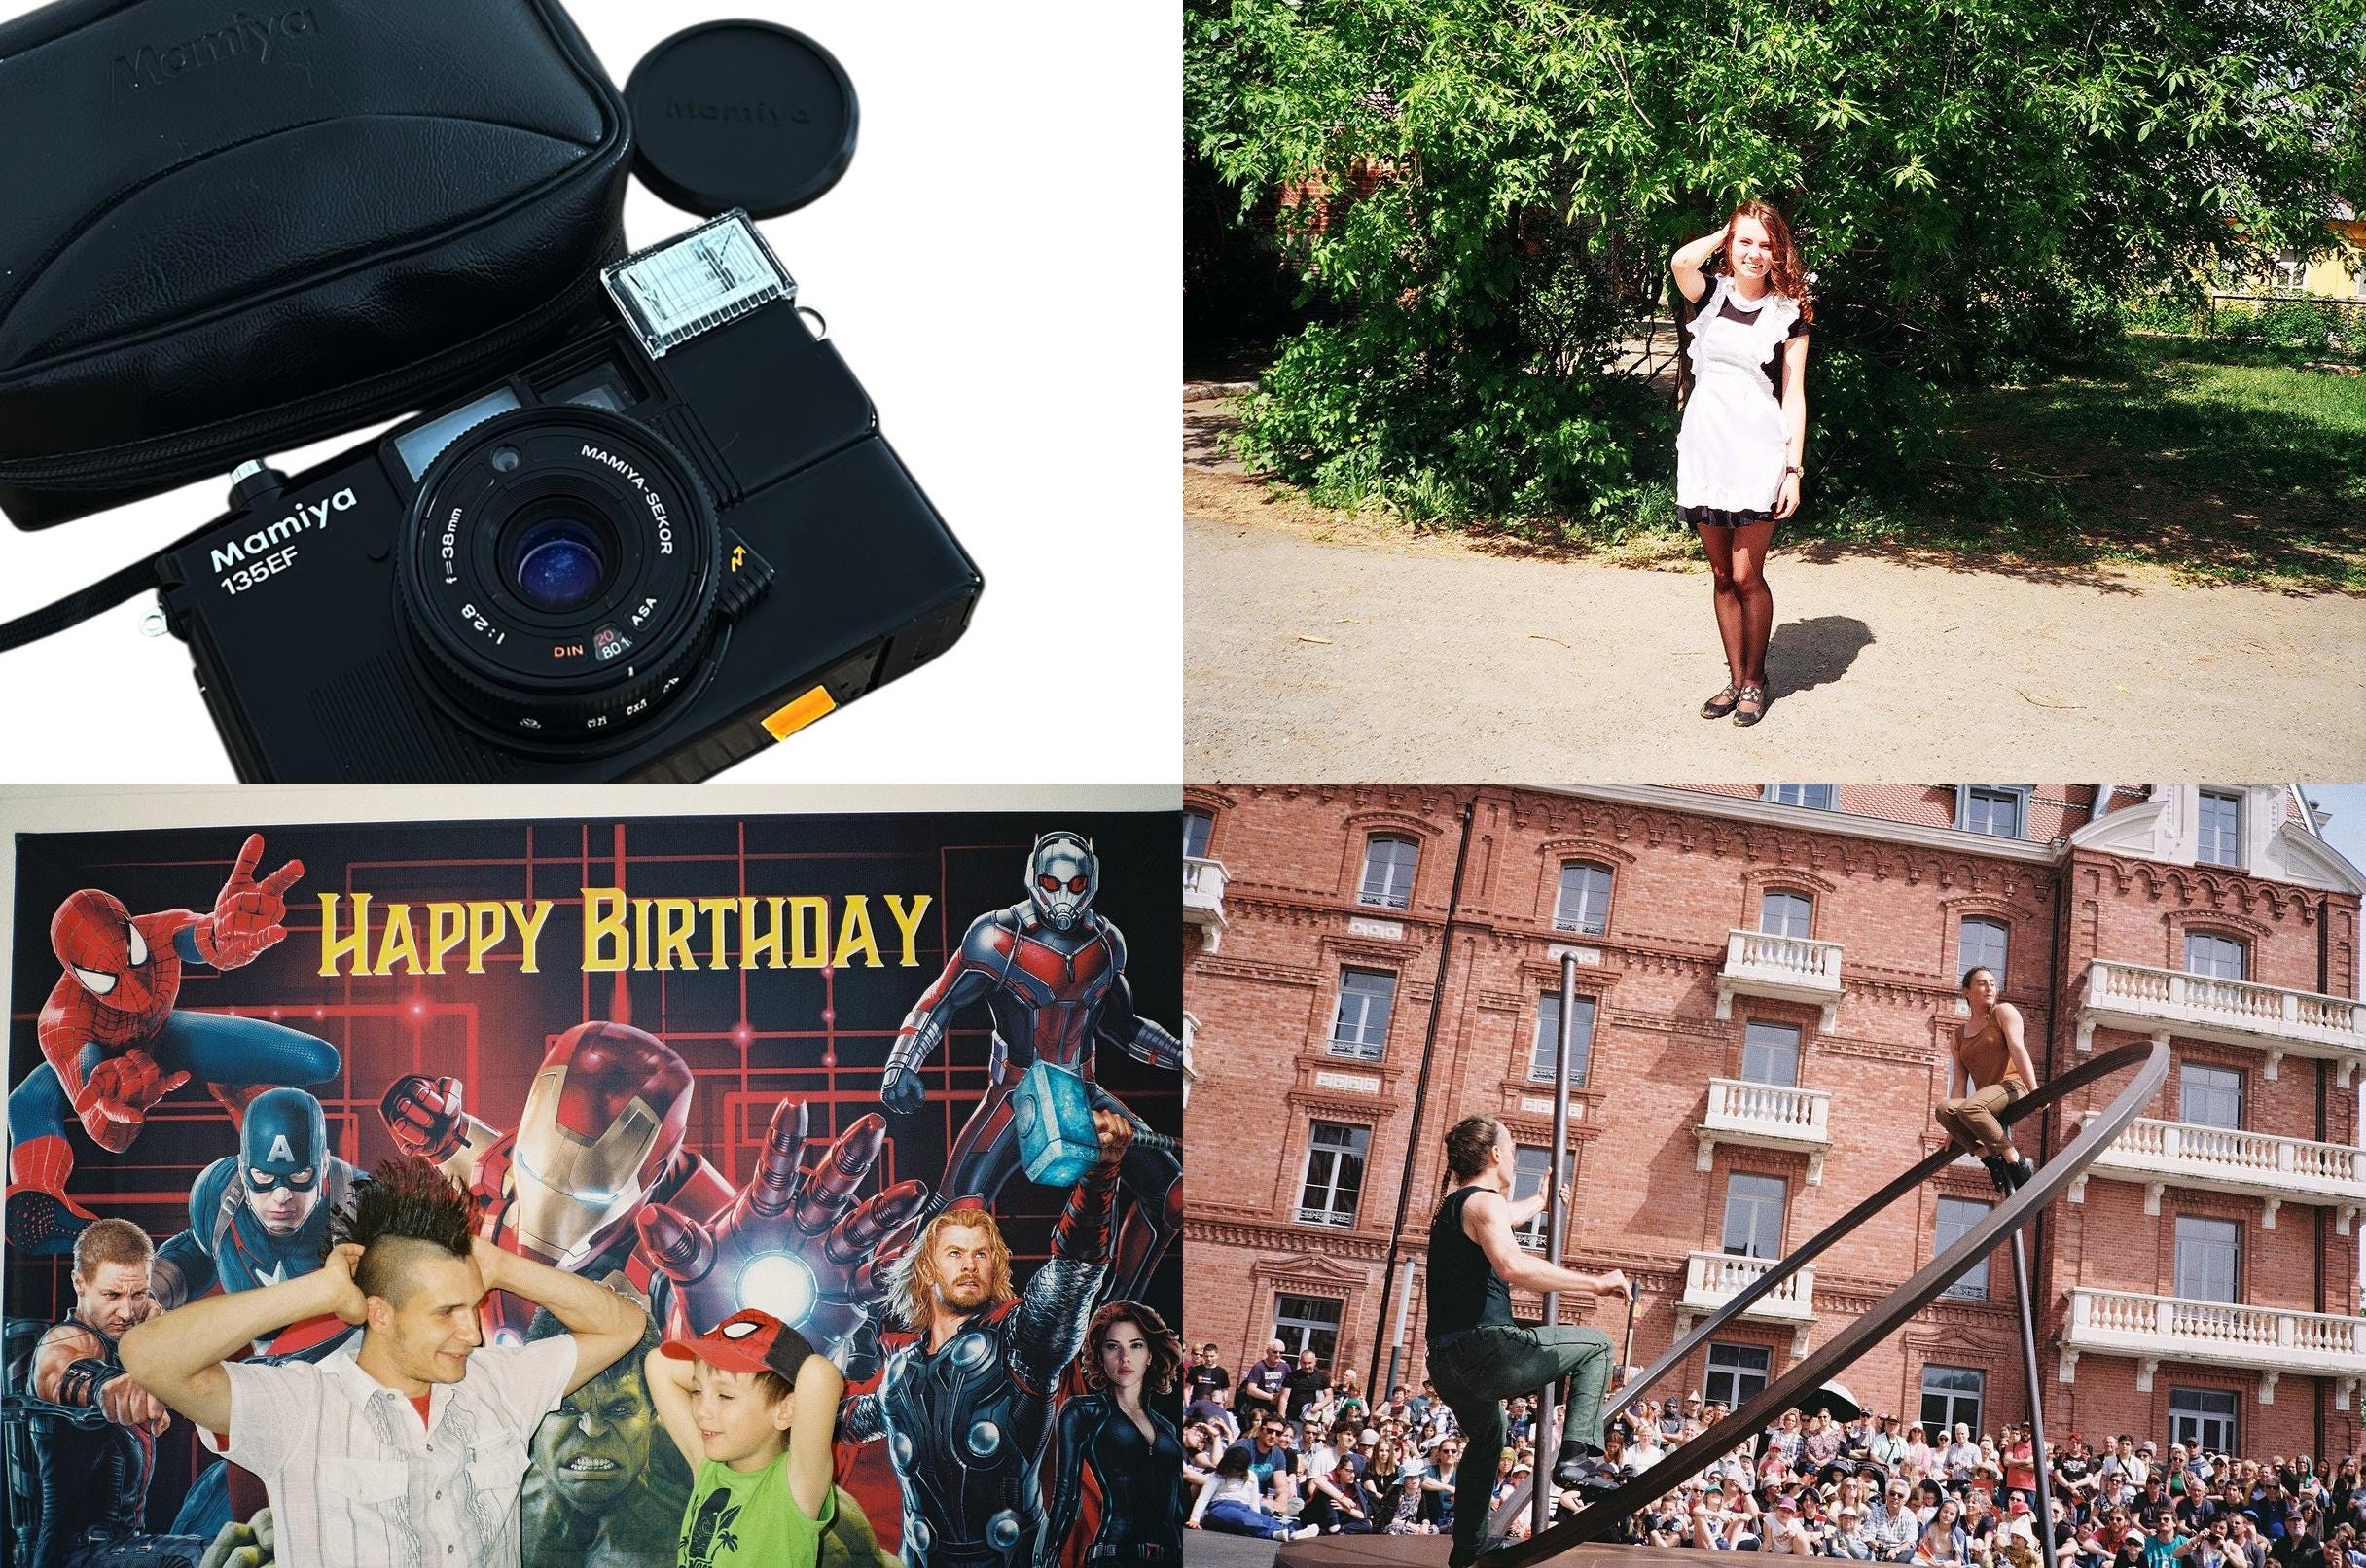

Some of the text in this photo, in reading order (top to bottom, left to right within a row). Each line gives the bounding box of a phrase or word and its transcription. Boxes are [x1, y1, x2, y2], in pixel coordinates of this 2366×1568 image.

[111, 8, 319, 102] Mamiya
[581, 445, 673, 555] MAMIYA-SEKOR
[210, 487, 357, 573] Mamiya
[441, 507, 463, 584] f=38mm
[221, 545, 298, 595] 135EF
[631, 596, 658, 626] ASA
[554, 644, 584, 658] DIN
[596, 628, 615, 646] 20
[601, 641, 622, 659] 80
[317, 886, 933, 977] HAPPY BIRTHDAY
[266, 1134, 296, 1163] A
